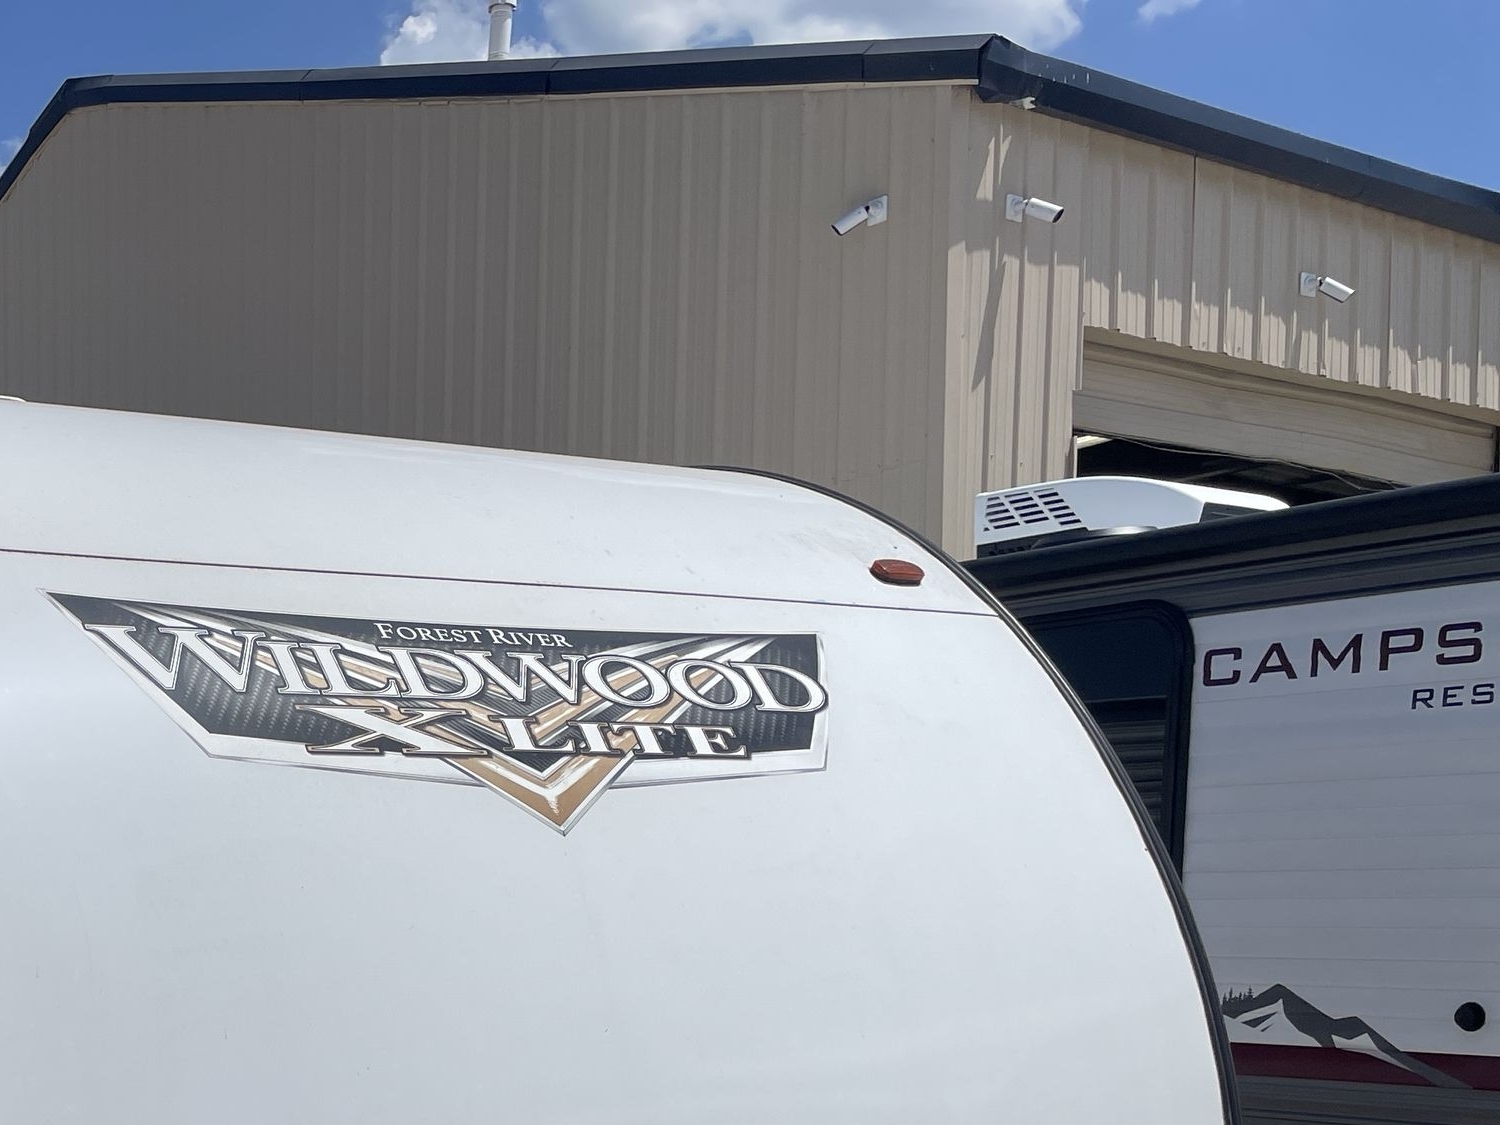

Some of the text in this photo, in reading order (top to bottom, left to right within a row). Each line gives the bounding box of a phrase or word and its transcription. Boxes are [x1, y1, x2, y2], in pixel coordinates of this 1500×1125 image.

[374, 622, 574, 648] FOREST RIVER
[1202, 621, 1483, 687] CAMPS
[82, 623, 827, 713] WILDWOOD
[1411, 683, 1495, 710] RES
[295, 704, 753, 761] X LITE
